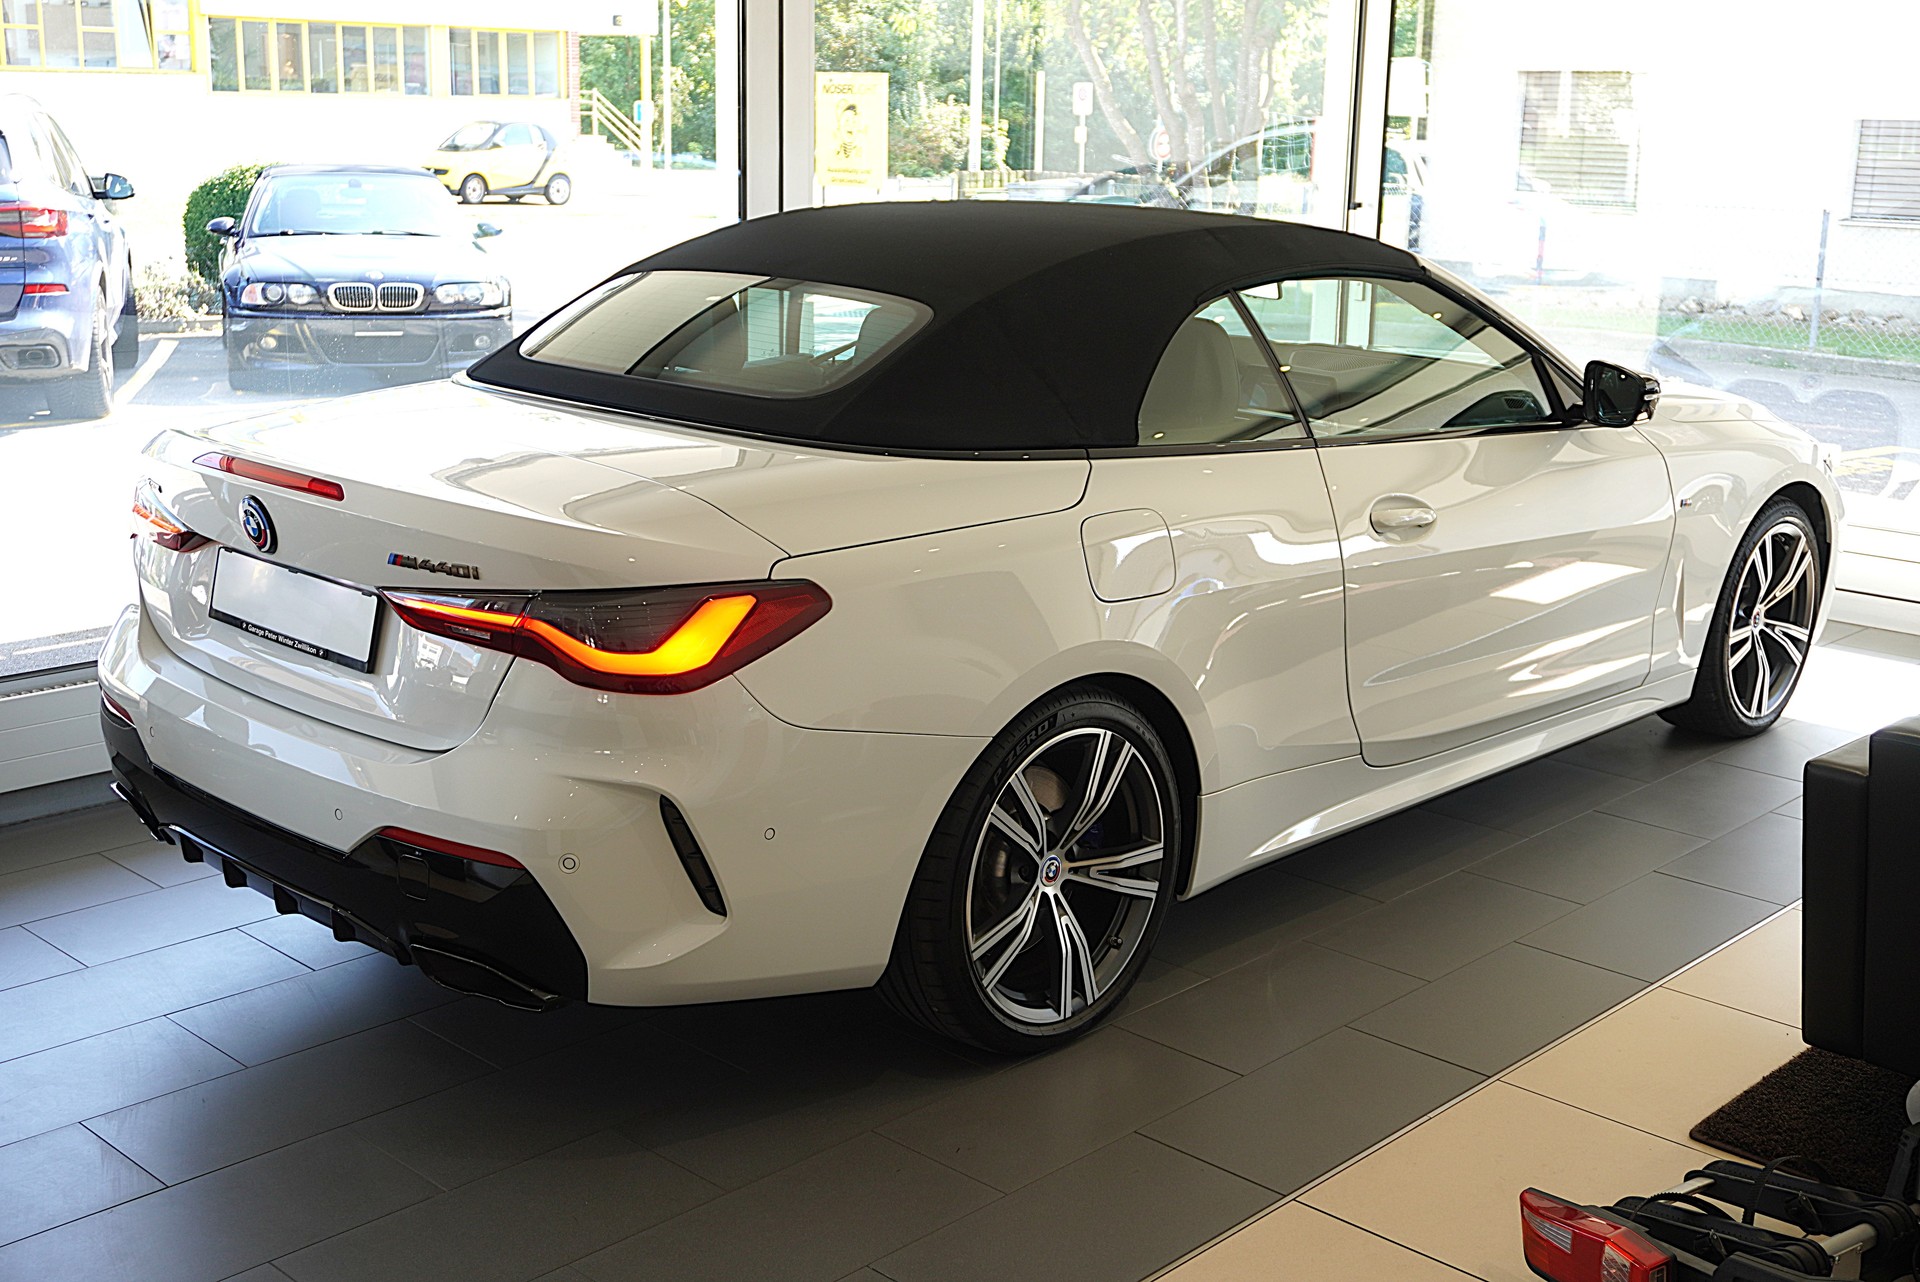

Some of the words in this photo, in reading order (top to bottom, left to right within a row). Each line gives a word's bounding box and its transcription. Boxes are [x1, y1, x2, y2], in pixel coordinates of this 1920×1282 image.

[398, 554, 480, 580] M440i
[247, 624, 264, 637] Garage
[264, 630, 278, 641] Peter
[278, 635, 294, 646] Winter
[294, 640, 317, 654] Zwillikon
[993, 767, 1002, 786] P
[1005, 719, 1049, 768] ZERO
